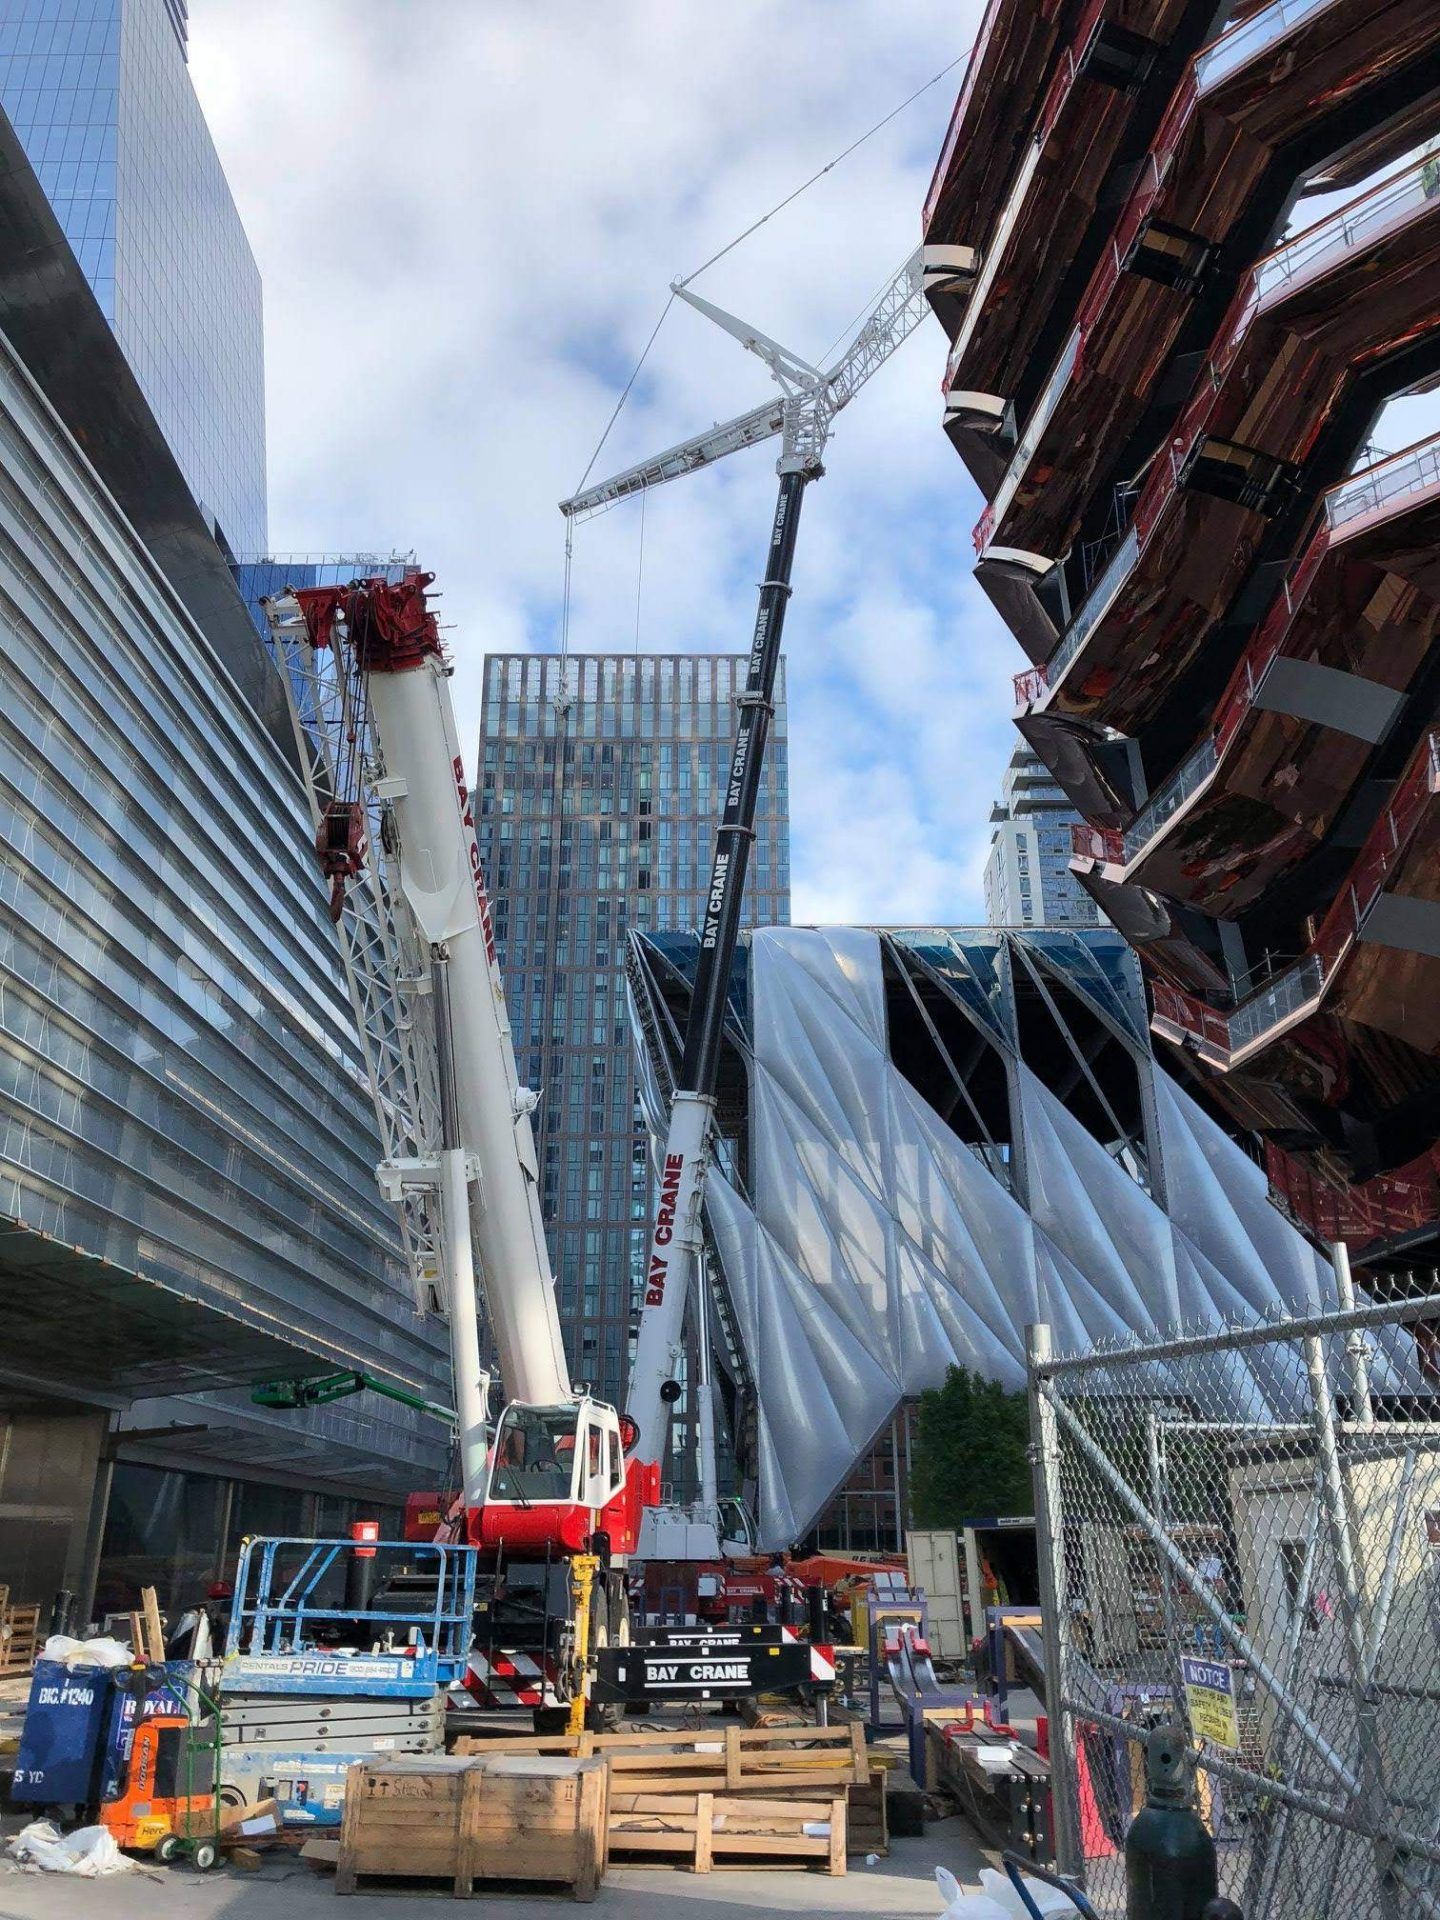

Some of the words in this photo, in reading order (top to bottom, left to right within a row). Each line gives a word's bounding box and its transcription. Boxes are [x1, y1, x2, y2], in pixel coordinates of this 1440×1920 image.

[776, 493, 789, 527] CRANE
[773, 527, 783, 546] BAY
[751, 650, 762, 674] BAY
[758, 607, 769, 648] CRANE
[734, 728, 750, 778] CRANE
[728, 780, 741, 807] BAY
[453, 755, 474, 828] BAY
[470, 842, 497, 968] CRANE
[710, 853, 729, 912] CRANE
[703, 914, 720, 949] BAY
[655, 1153, 684, 1246] CRANE
[645, 1254, 669, 1307] BAY
[699, 1638, 739, 1646] CRANE
[290, 1661, 349, 1675] PRIDE
[647, 1667, 679, 1681] BAY
[690, 1665, 748, 1680] CRANE
[1189, 1664, 1226, 1689] NOTCE
[13, 1769, 25, 1783] 5
[138, 1735, 151, 1791] DOOSAN
